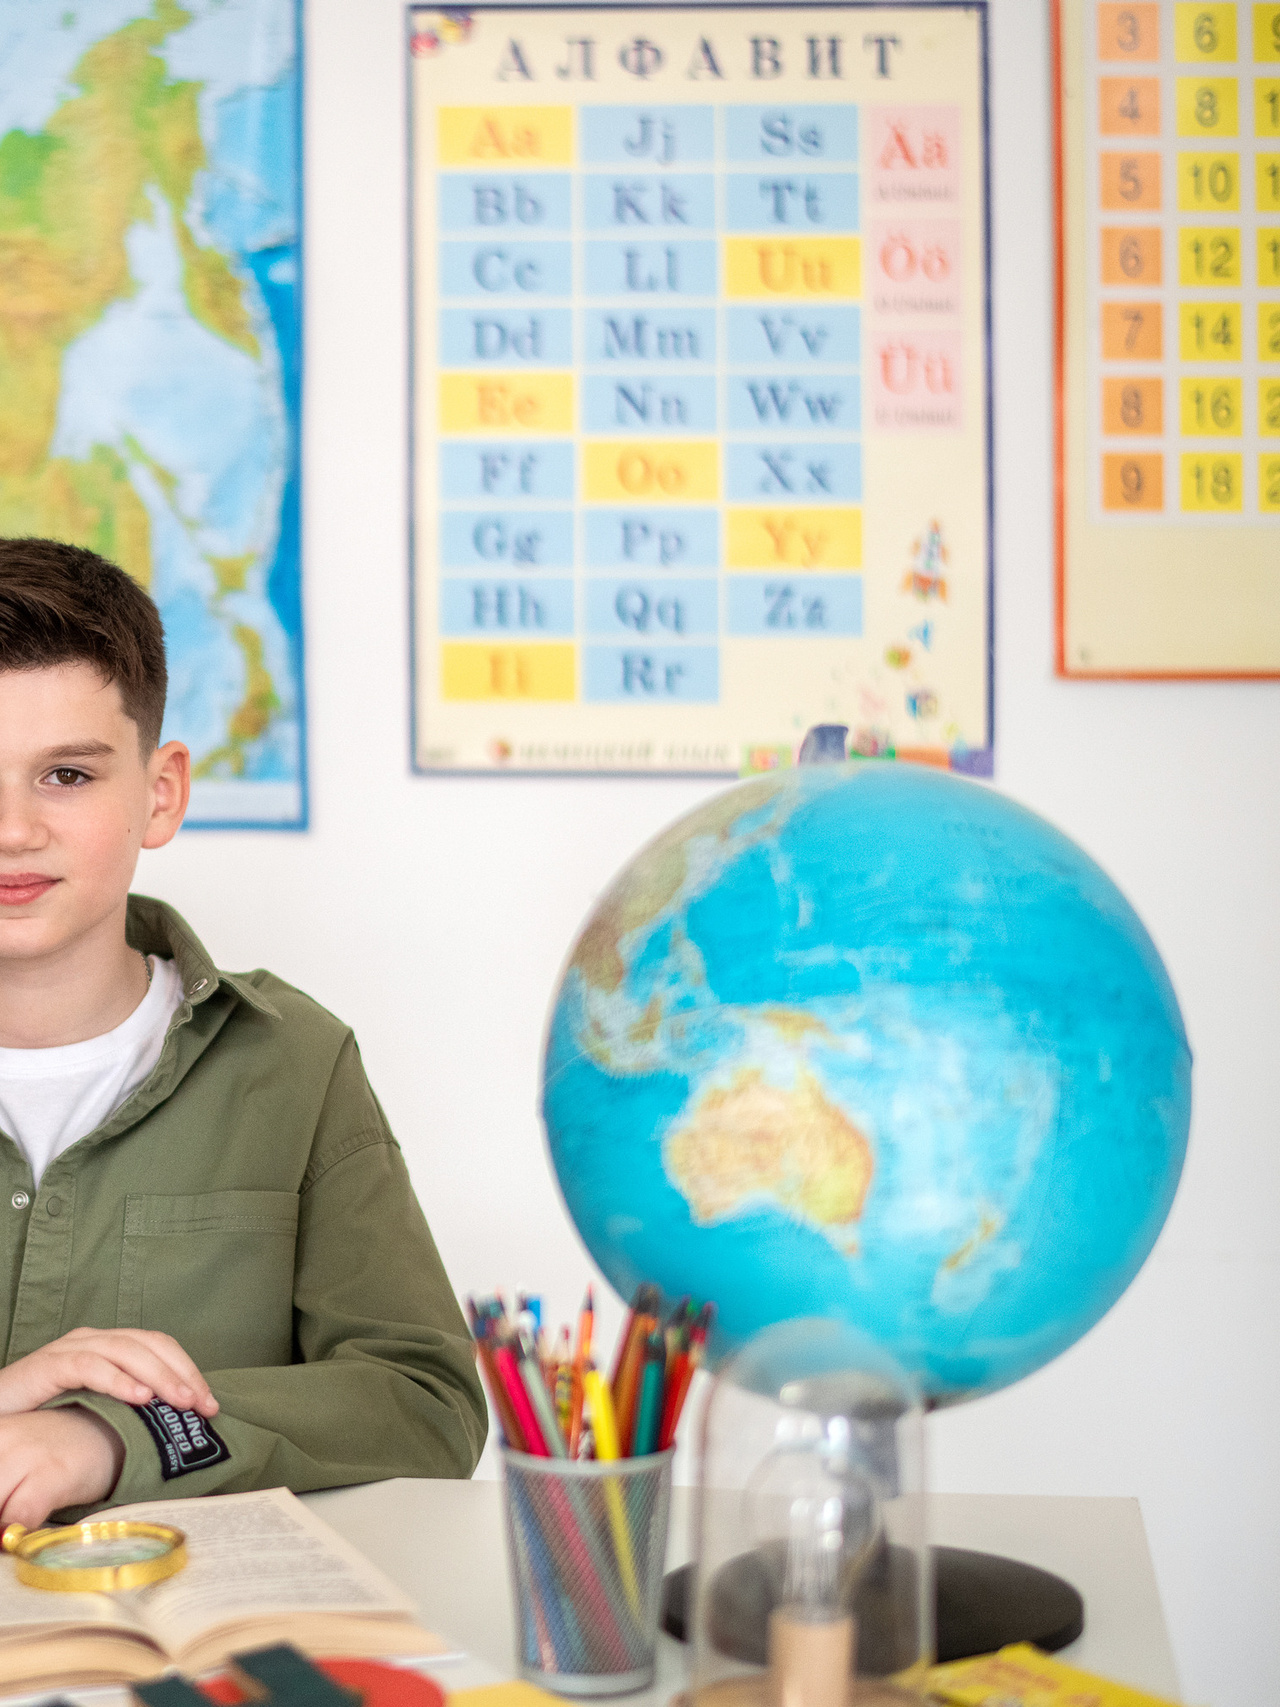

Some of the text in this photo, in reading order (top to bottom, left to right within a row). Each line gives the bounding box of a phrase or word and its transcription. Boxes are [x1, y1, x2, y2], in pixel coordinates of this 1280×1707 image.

[1118, 11, 1219, 53] 3 6
[497, 35, 902, 80] АЛФАВИТ
[1119, 89, 1142, 122] 4
[1195, 87, 1219, 127] 8
[1120, 160, 1143, 201] 5
[1191, 161, 1234, 203] 10
[1120, 236, 1144, 277] 6
[1192, 236, 1234, 279] 12
[1122, 309, 1144, 353] 7
[1192, 311, 1234, 352] 14
[1121, 387, 1144, 427] 8
[1193, 387, 1234, 428] 16
[1121, 462, 1145, 503] 9
[1193, 462, 1234, 503] 18
[158, 1404, 193, 1454] BORED
[182, 1409, 208, 1449] UNG
